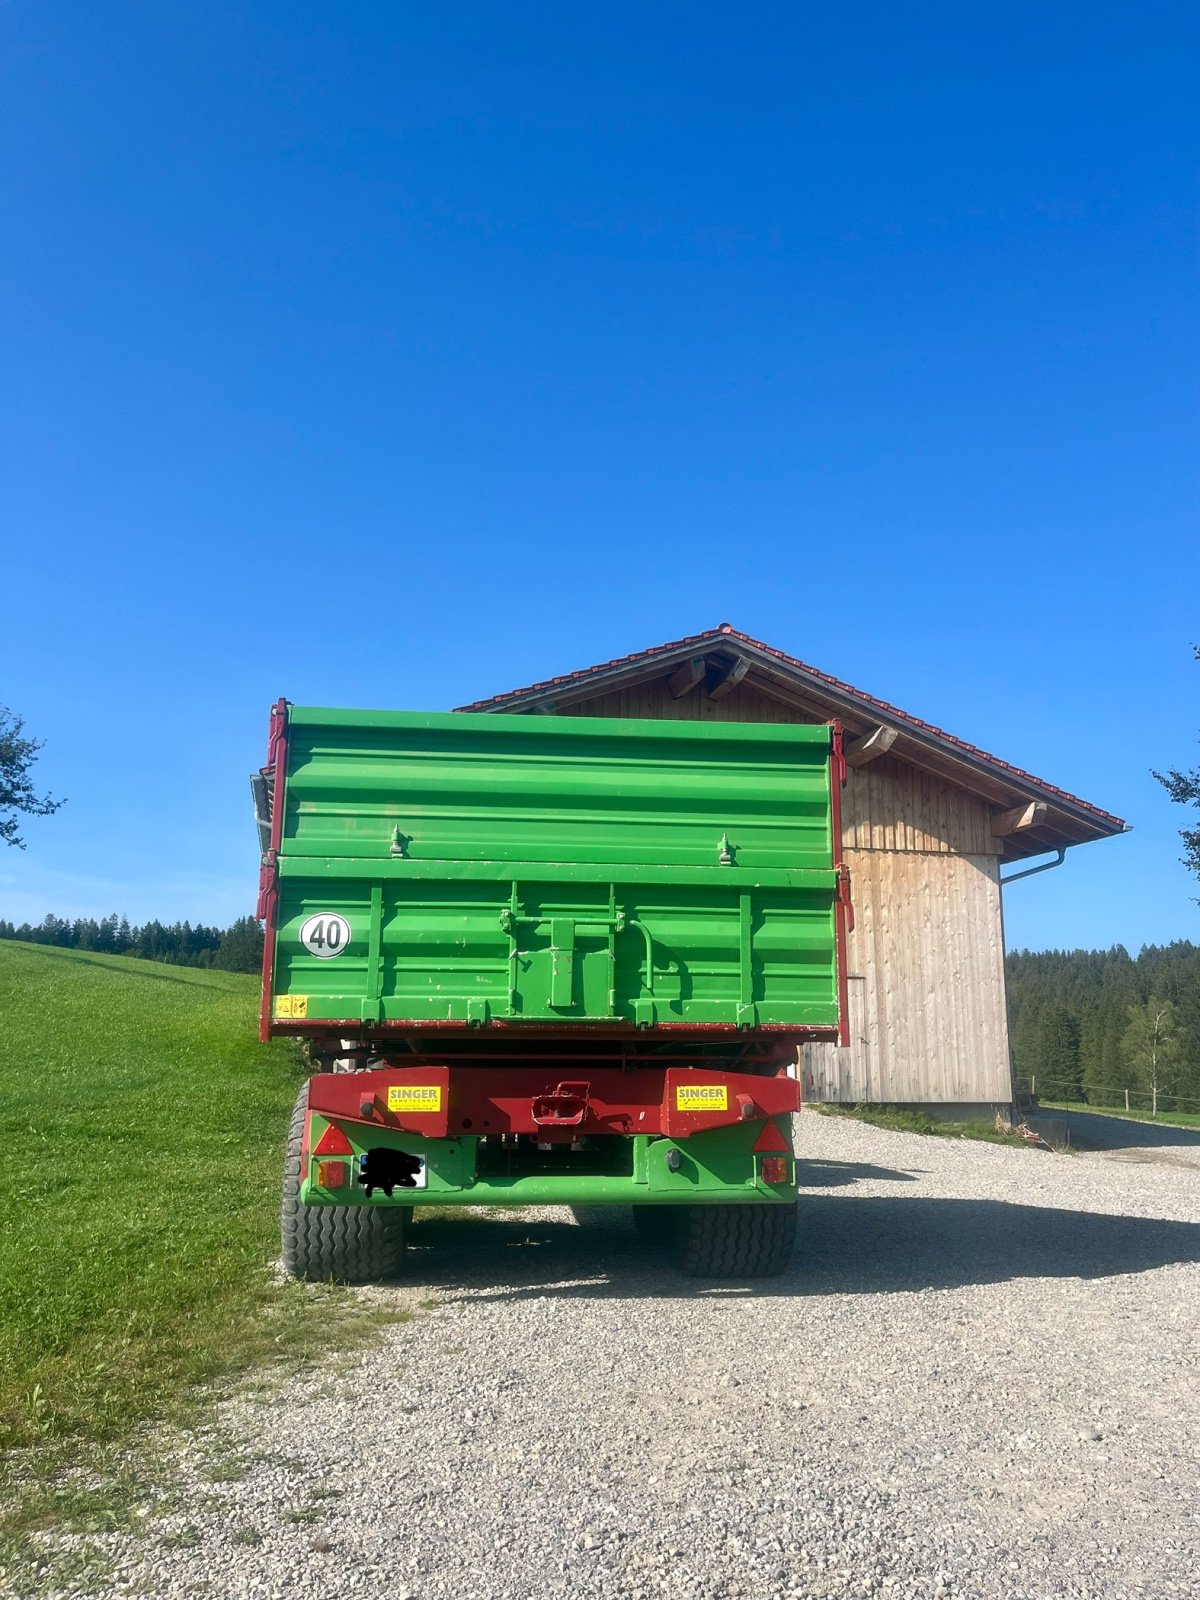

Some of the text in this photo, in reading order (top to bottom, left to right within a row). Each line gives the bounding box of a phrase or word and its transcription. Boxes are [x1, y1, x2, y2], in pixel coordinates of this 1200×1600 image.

[310, 920, 341, 949] 40
[390, 1089, 437, 1099] SINGER
[679, 1088, 724, 1098] SINGER
